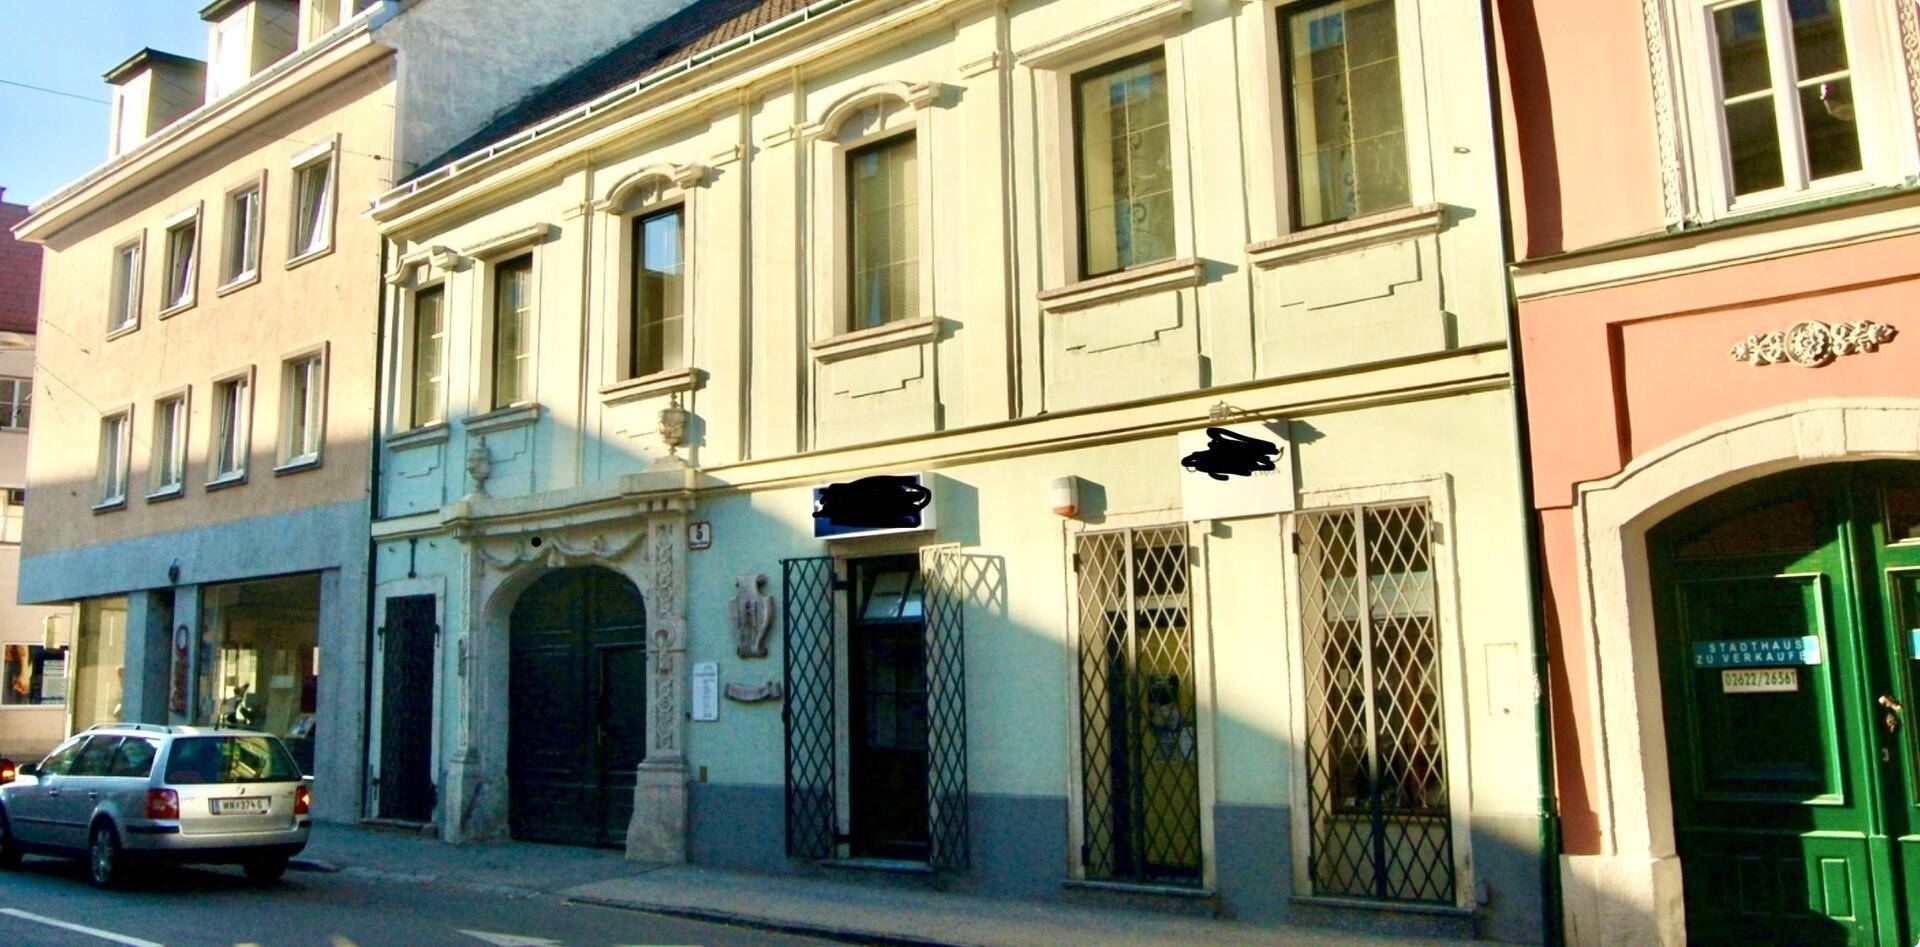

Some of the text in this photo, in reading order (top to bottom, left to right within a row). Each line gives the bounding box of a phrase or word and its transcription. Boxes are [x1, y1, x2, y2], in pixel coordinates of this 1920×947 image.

[1709, 640, 1803, 653] STADTHAUS
[1696, 651, 1812, 665] ZU VERKAUFE
